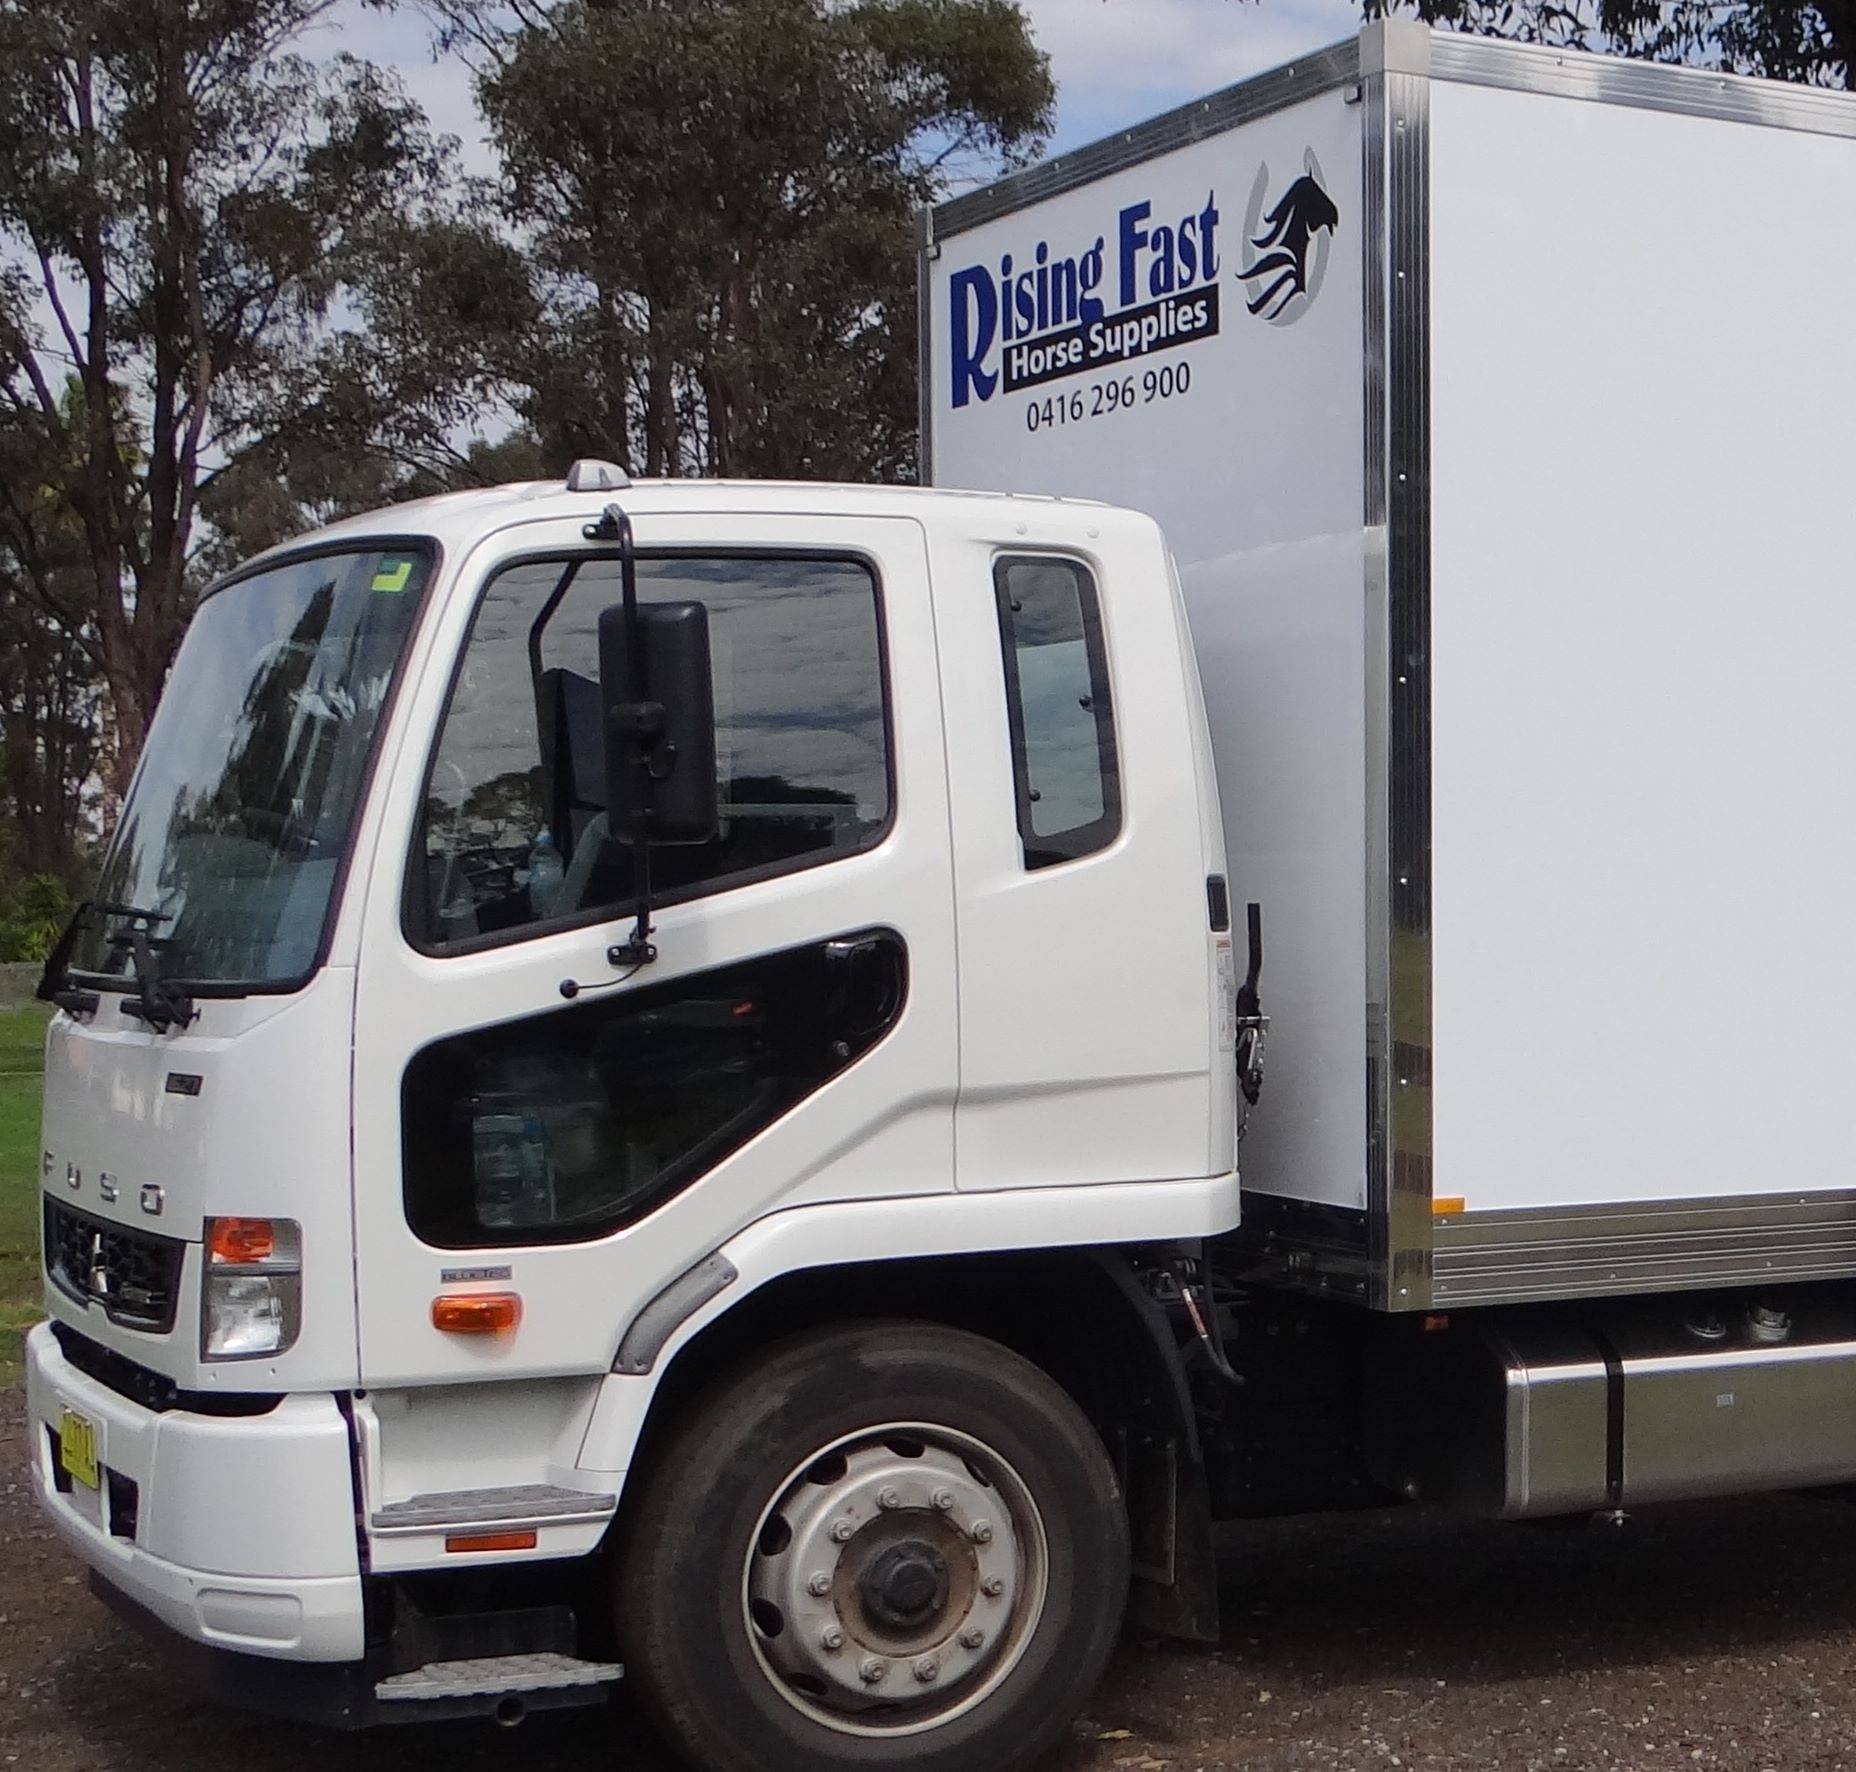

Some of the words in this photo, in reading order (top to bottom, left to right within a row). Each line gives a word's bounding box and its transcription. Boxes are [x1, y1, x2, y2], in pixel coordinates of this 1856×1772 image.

[950, 235, 1105, 409] Rising
[1119, 189, 1221, 306] Fast
[1011, 337, 1083, 381] Horse
[1089, 299, 1208, 359] Supplies
[1026, 389, 1084, 433] 0416
[1090, 374, 1135, 417] 296
[1144, 361, 1191, 404] 900
[43, 1149, 165, 1216] FUSO
